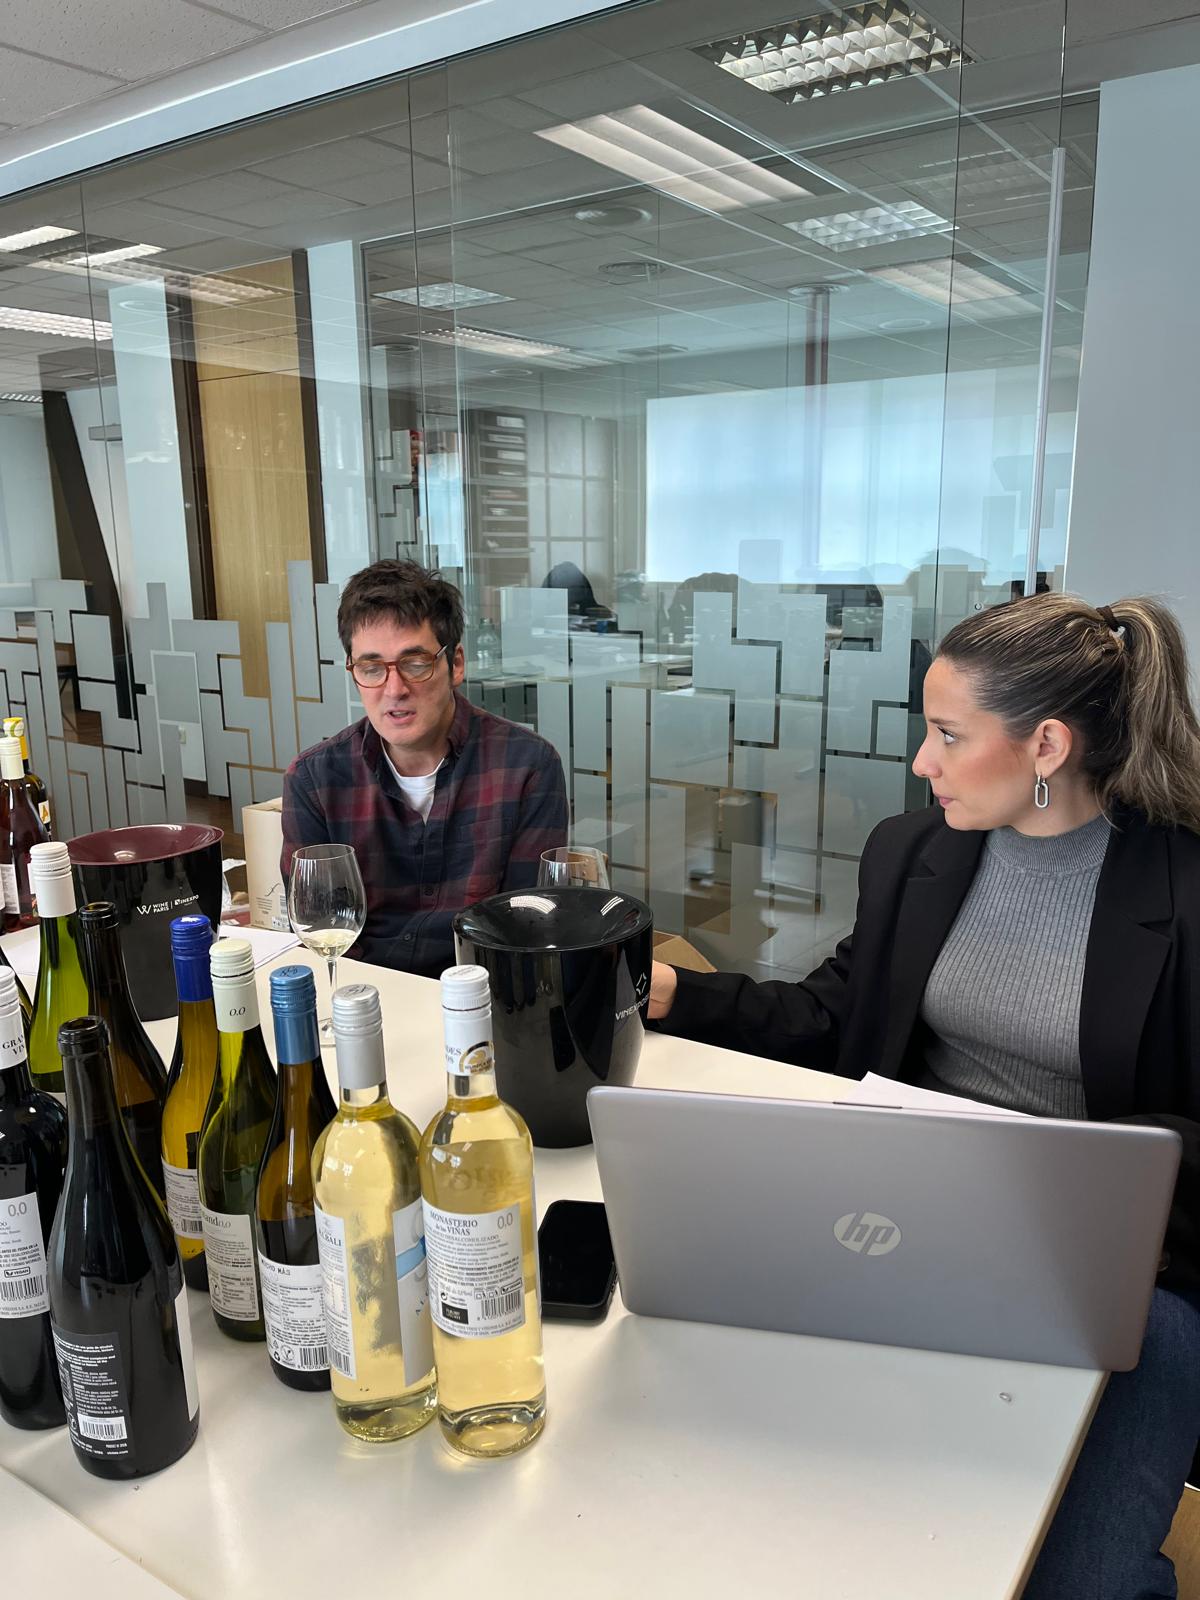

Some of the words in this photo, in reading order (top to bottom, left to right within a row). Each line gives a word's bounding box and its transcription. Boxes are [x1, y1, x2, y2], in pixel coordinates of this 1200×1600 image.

[153, 901, 169, 909] WINE
[8, 1202, 27, 1217] 0,0
[430, 1210, 478, 1228] MONASTERIO
[497, 1212, 513, 1230] 0,0
[841, 1211, 896, 1255] hp
